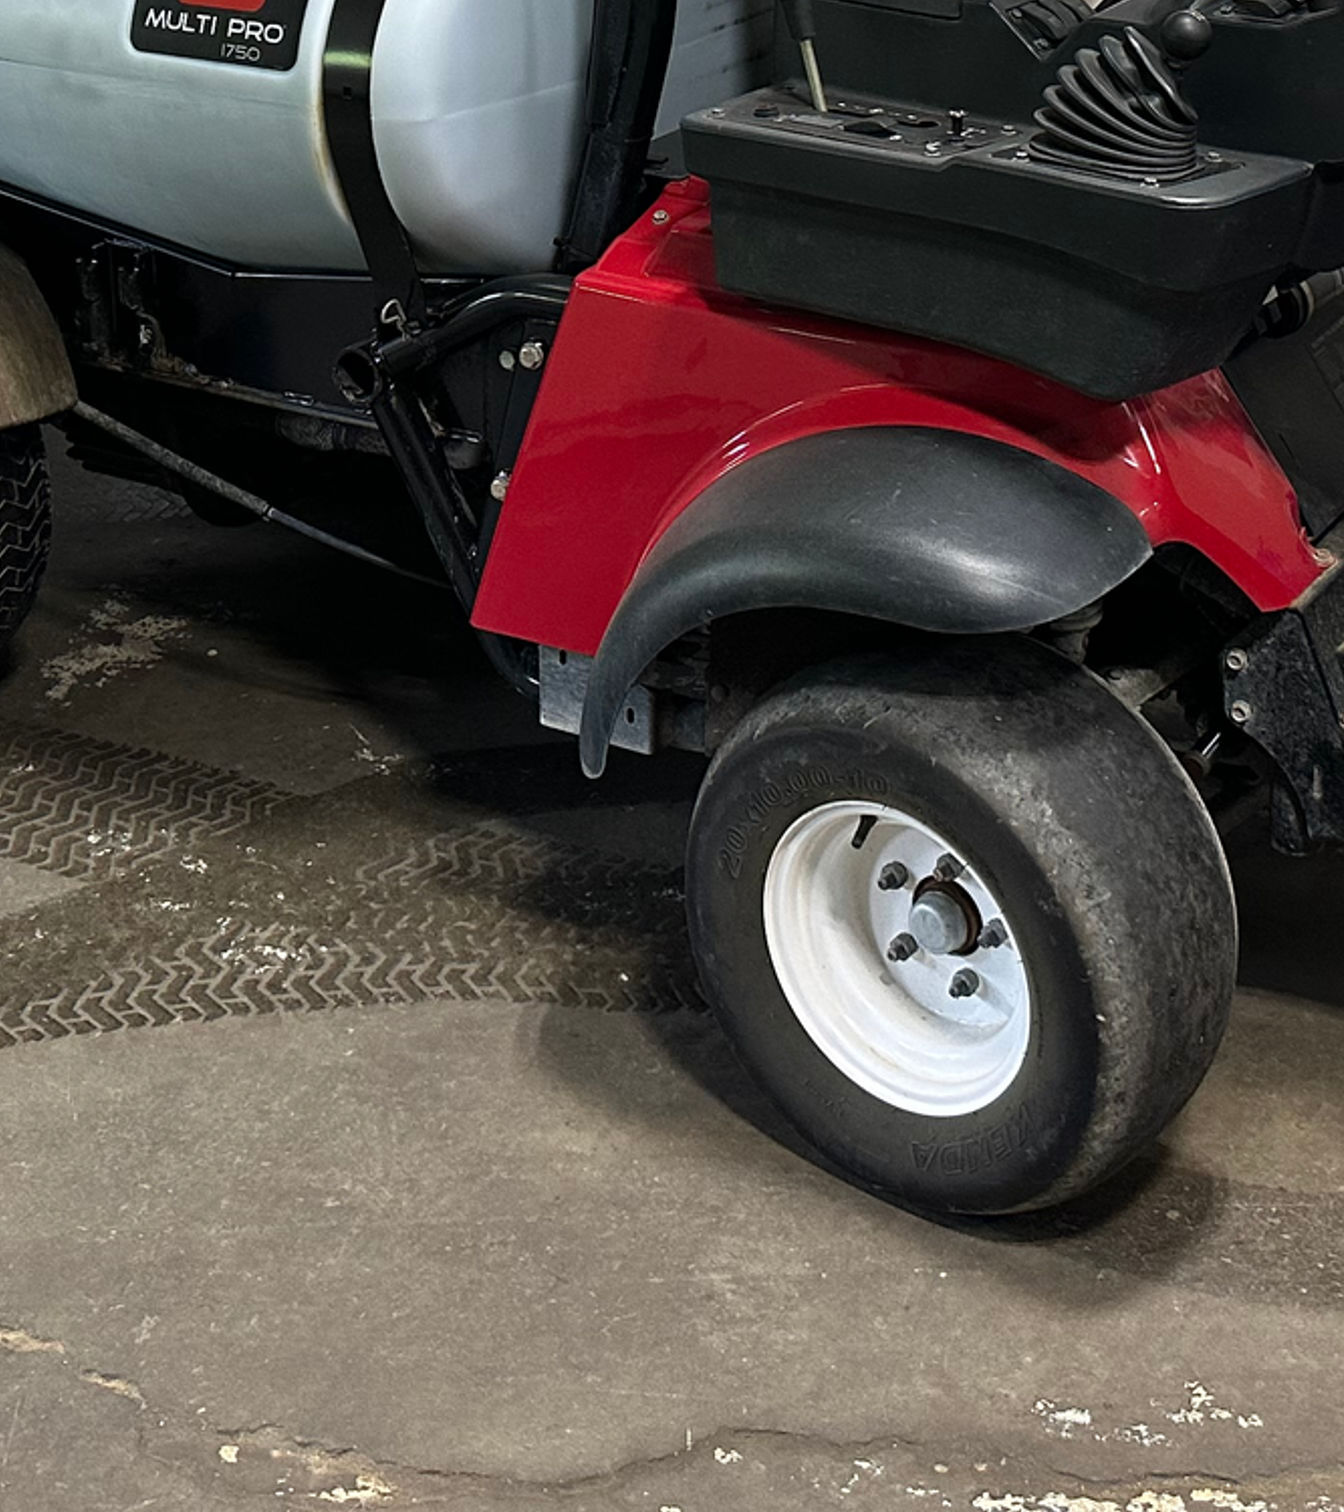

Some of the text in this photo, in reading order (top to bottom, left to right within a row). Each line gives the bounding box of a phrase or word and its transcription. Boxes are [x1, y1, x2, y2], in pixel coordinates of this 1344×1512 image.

[144, 7, 284, 44] MULTI PRO
[221, 43, 261, 62] 1750
